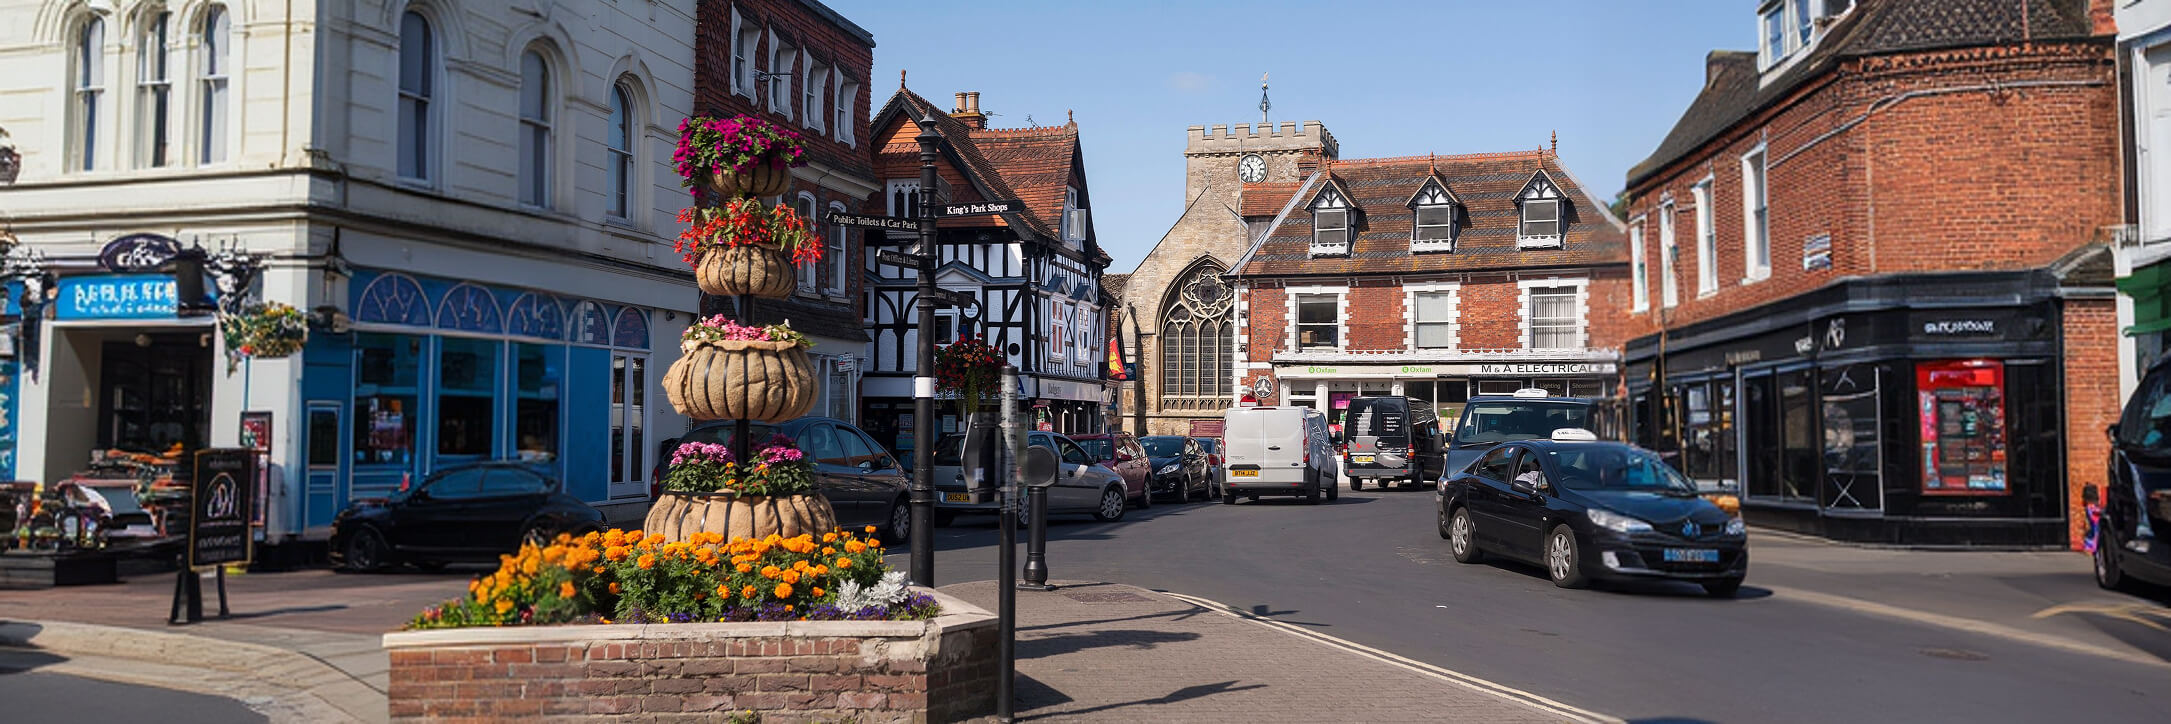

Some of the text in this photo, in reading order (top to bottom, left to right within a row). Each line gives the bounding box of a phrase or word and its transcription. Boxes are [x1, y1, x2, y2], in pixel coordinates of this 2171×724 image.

[947, 203, 1008, 215] King's Park Shops
[833, 215, 918, 230] Public Toilets & Car Park
[1481, 364, 1492, 373] M
[1503, 364, 1512, 373] A
